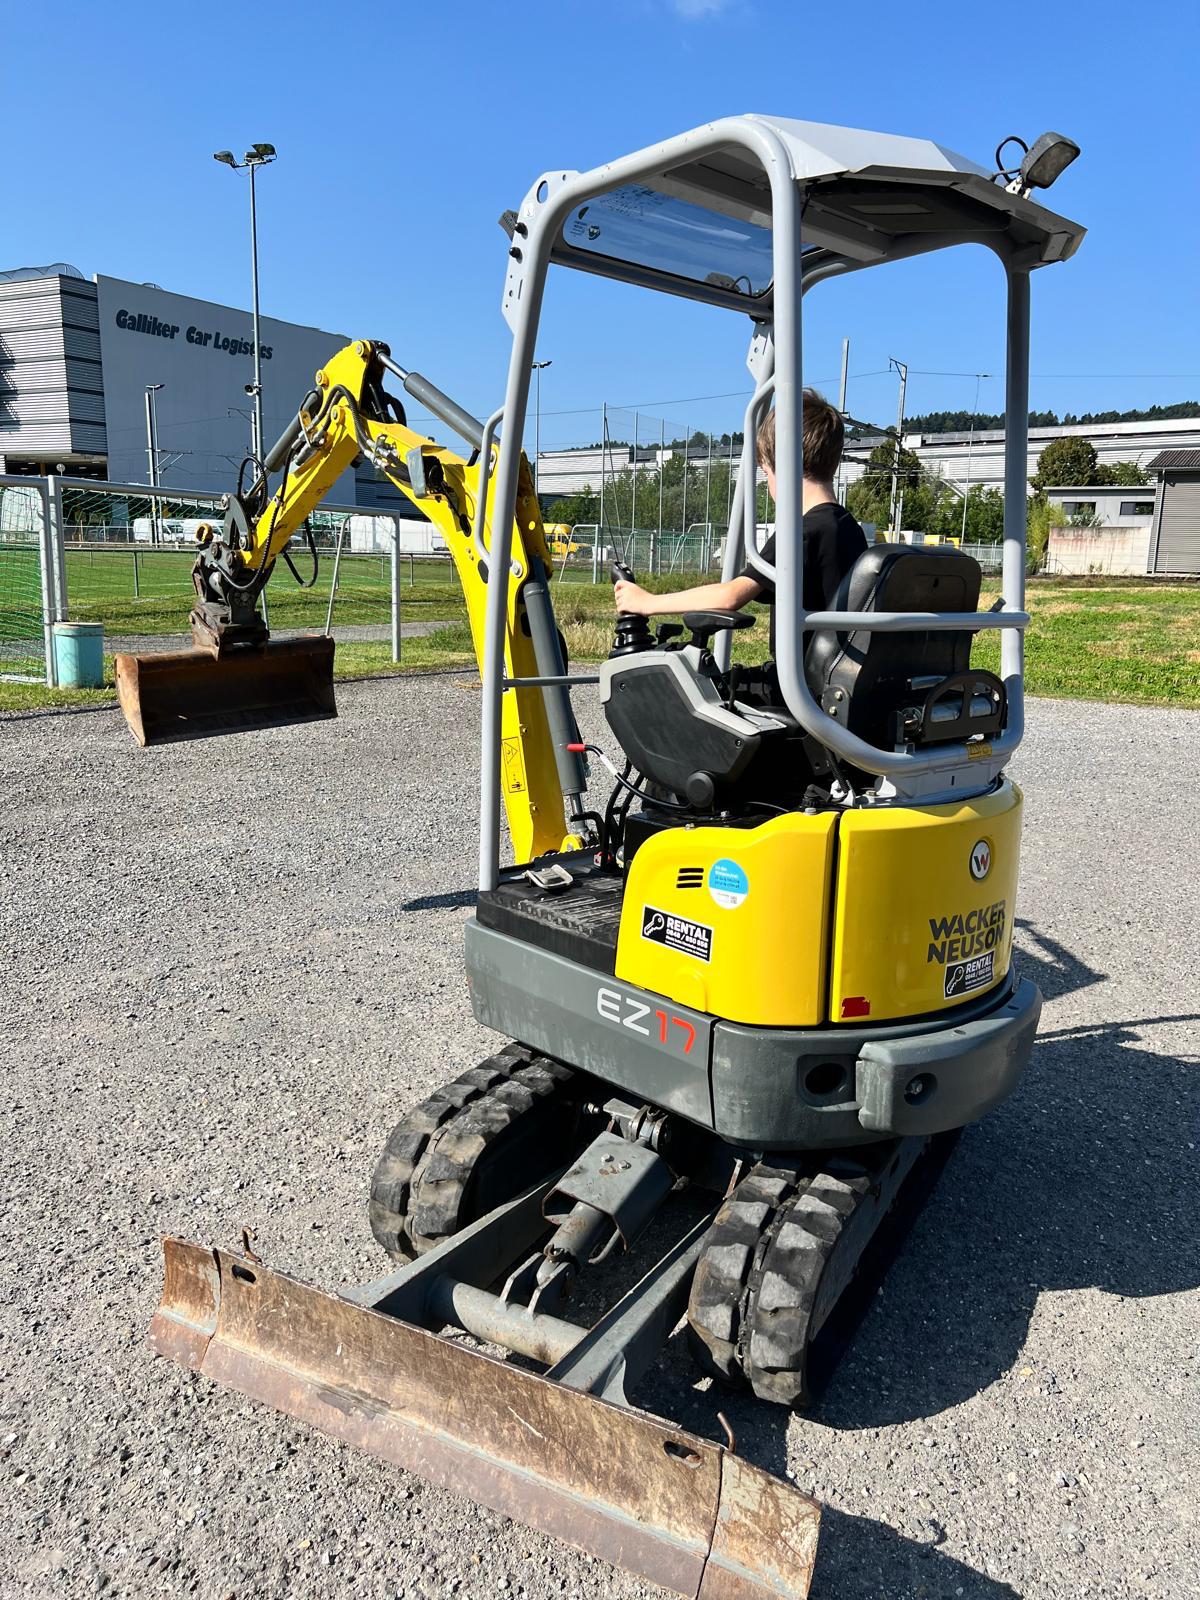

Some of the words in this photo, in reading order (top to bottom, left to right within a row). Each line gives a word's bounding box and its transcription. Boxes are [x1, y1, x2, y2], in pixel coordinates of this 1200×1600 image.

[116, 309, 179, 339] Galliker
[186, 326, 212, 347] Car
[213, 332, 273, 360] Logistcs
[666, 916, 709, 942] RENTAL
[929, 900, 1006, 940] WACKER
[927, 921, 1004, 964] NEUSON
[965, 954, 992, 974] RENTAL
